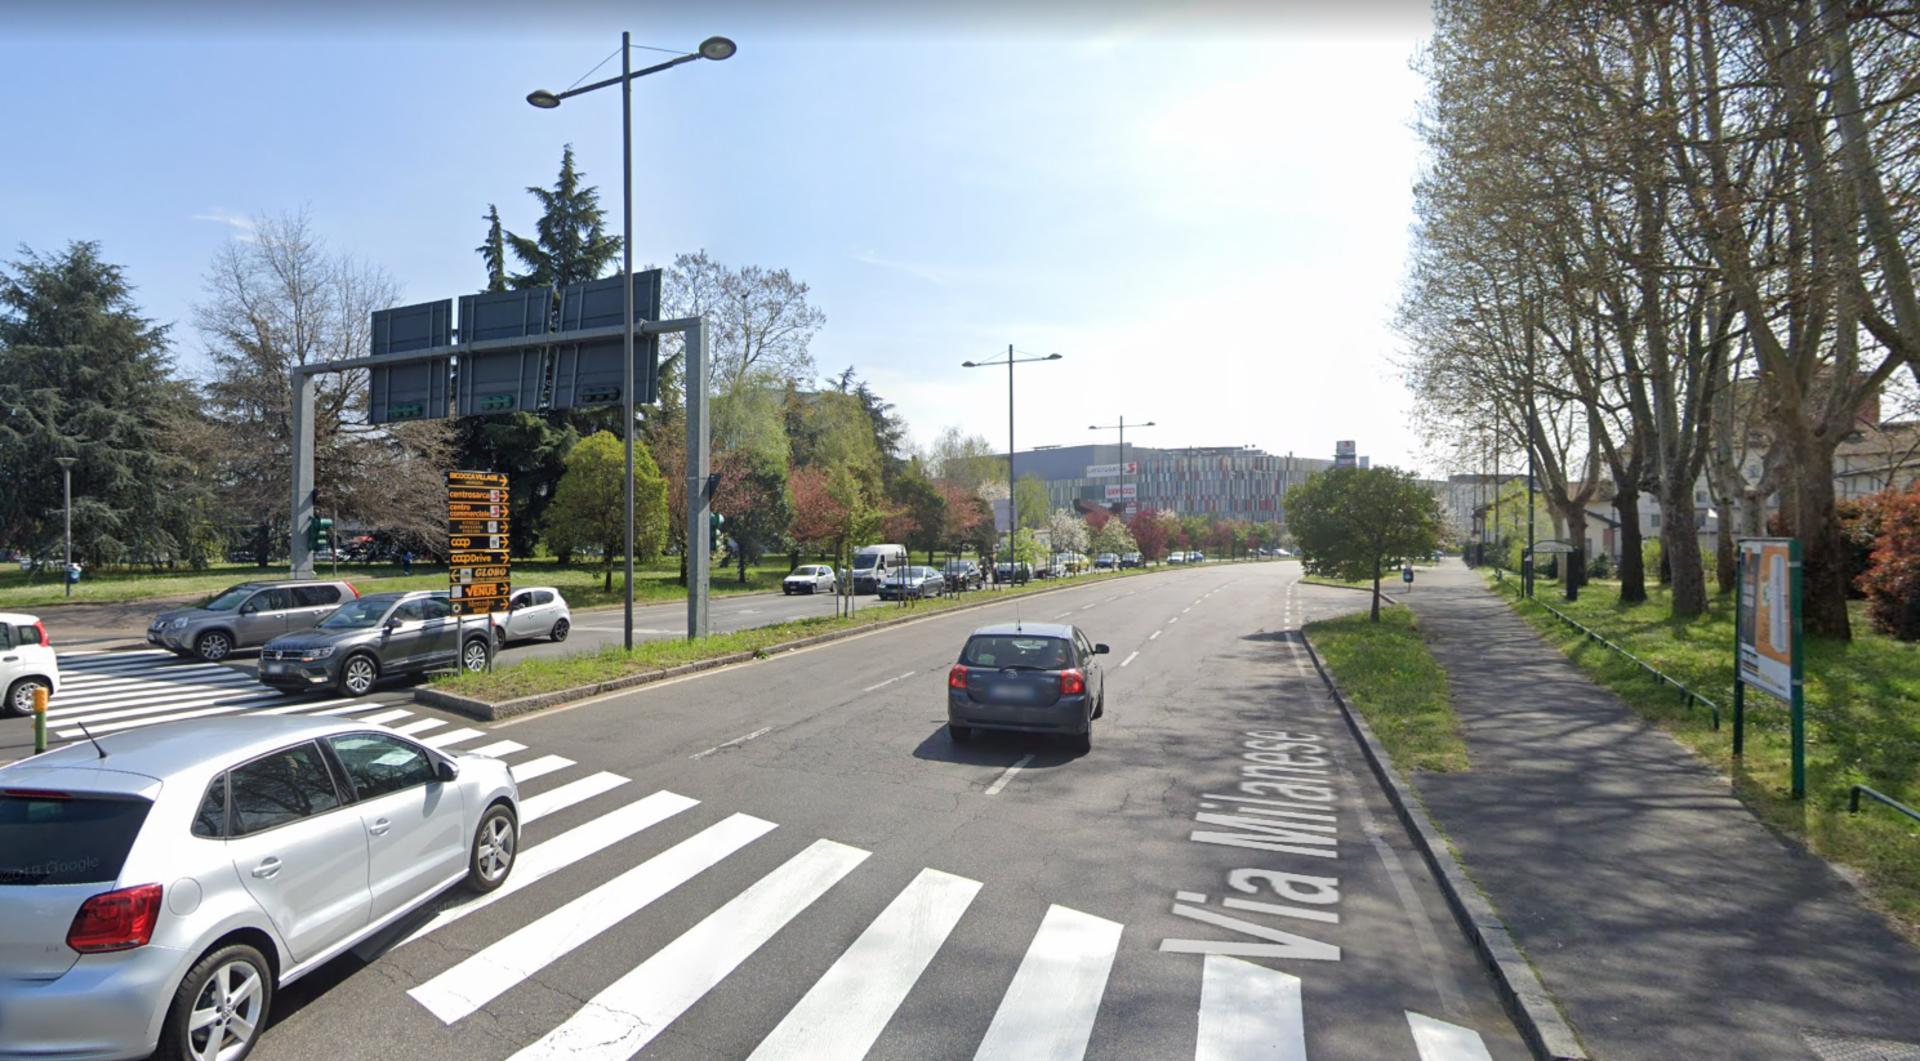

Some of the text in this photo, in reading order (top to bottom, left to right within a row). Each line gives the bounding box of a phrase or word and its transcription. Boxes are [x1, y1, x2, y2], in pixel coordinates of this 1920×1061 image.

[449, 490, 490, 499] centrosarca
[449, 503, 471, 511] centro
[451, 538, 471, 548] coop
[475, 568, 507, 577] GLOBO
[465, 583, 497, 597] VENUS
